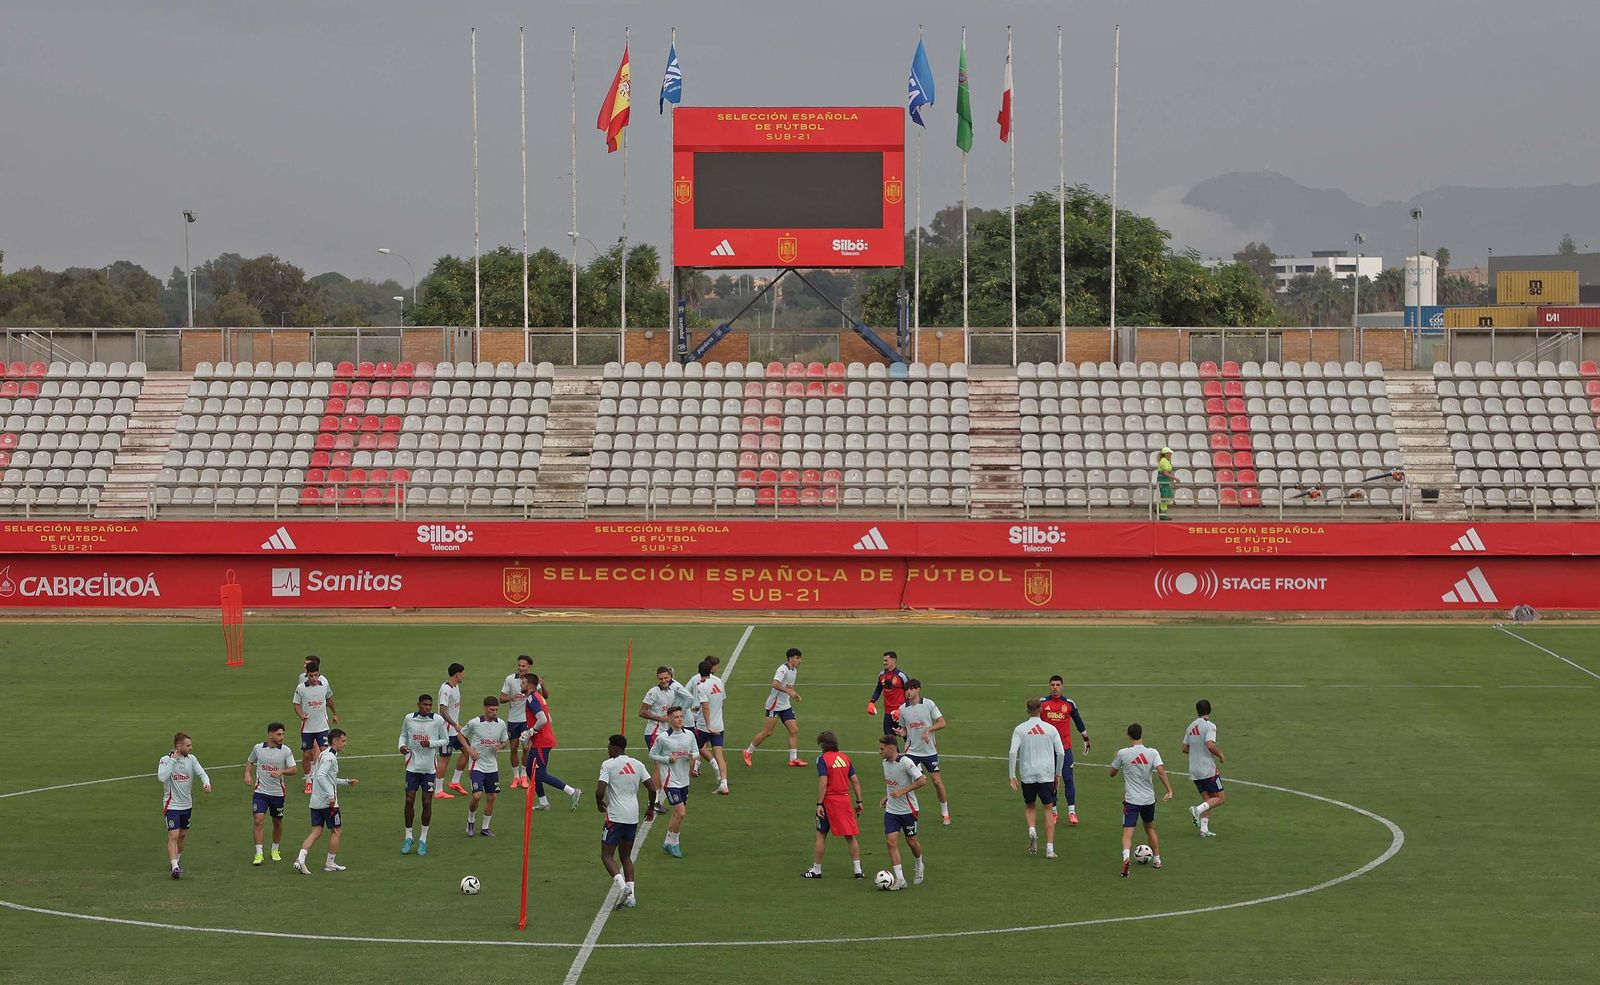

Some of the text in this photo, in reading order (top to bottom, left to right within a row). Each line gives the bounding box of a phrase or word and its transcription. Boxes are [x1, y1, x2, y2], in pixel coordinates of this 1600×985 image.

[717, 112, 859, 120] SELECCIÓN ESPAÑOLA
[755, 122, 825, 131] DE FÚTBOL
[766, 133, 810, 141] SUB-21
[4, 524, 139, 533] SELECCIÓN ESPAÑOLA
[594, 524, 730, 533] SELECCIÓN ESPAÑOLA
[1188, 525, 1325, 534] SELECCIÓN ESPAÑOLA
[61, 534, 107, 542] FÚTBOL
[652, 534, 697, 542] FÚTBOL
[1225, 535, 1292, 544] DE FÚTBOL
[641, 544, 683, 552] SUB-21
[543, 563, 1012, 582] SELECCIÓN ESPAÑOLA DE FÚTBOL
[306, 570, 403, 592] Sanitas
[1222, 577, 1328, 590] STAGE FRONT
[732, 588, 820, 602] SUB-21
